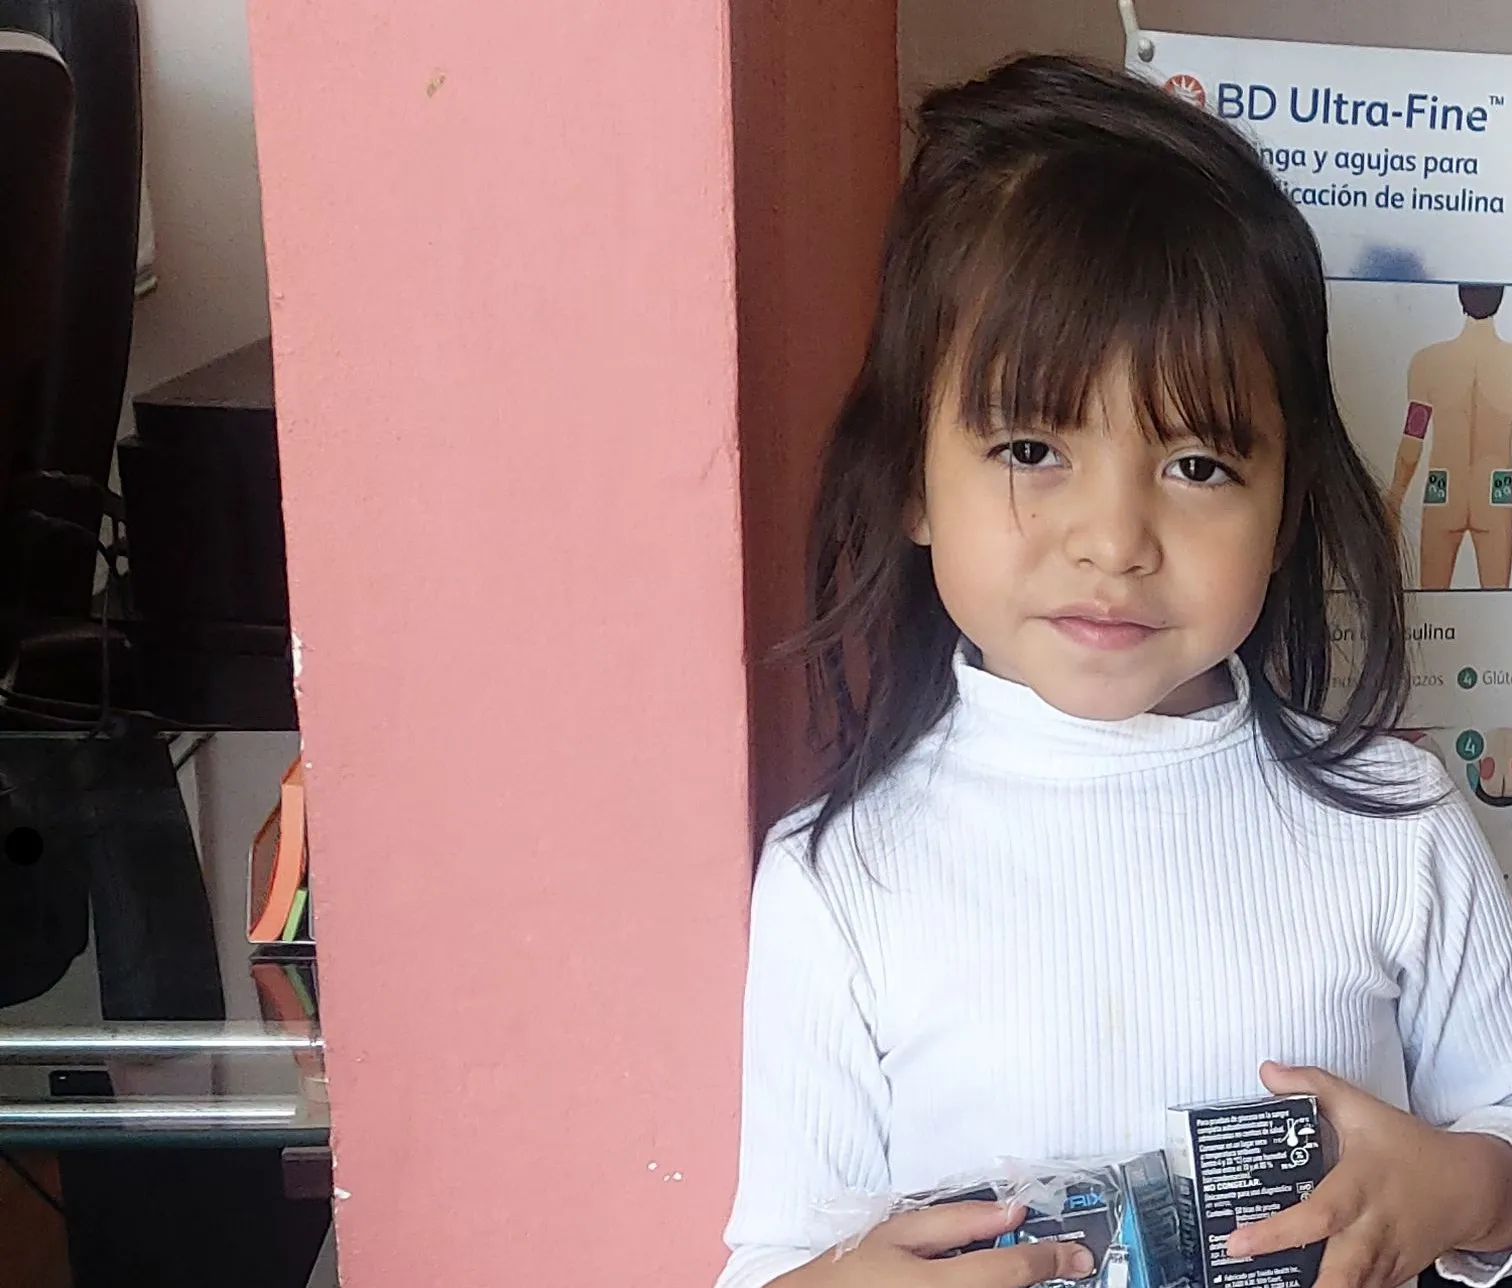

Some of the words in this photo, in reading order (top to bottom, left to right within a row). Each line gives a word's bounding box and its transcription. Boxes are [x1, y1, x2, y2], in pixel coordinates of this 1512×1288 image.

[1217, 83, 1277, 121] BD
[1312, 150, 1328, 174] y
[1334, 150, 1416, 177] agujas
[1423, 156, 1479, 179] para
[1375, 185, 1404, 208] de
[1412, 187, 1505, 214] insulina
[1463, 737, 1476, 755] 4
[1203, 1184, 1216, 1192] NO
